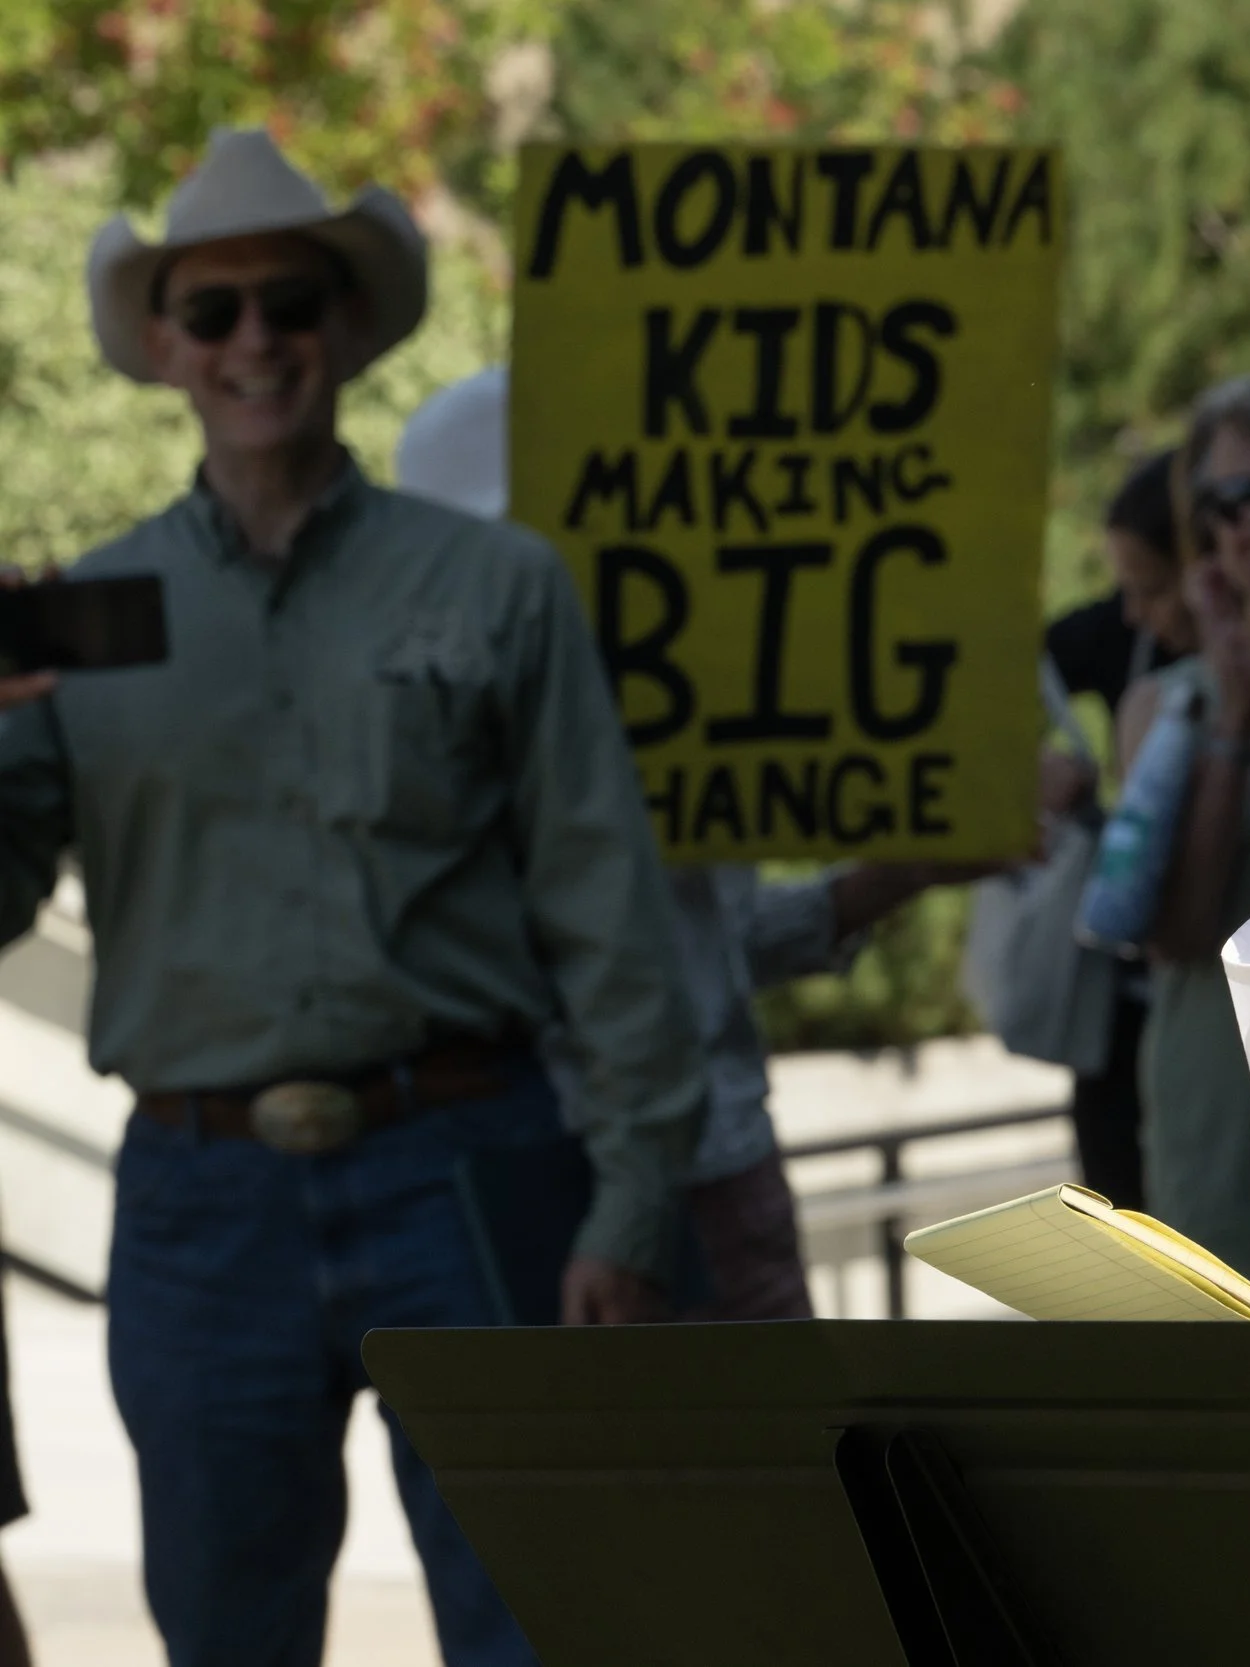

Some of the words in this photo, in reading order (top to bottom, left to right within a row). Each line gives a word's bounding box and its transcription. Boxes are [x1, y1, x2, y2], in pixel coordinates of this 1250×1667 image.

[528, 150, 1053, 280] MONTANA
[643, 298, 959, 439] KIDS
[563, 444, 951, 533] MAKING
[594, 525, 959, 746] BIG
[646, 752, 955, 845] HANGE
